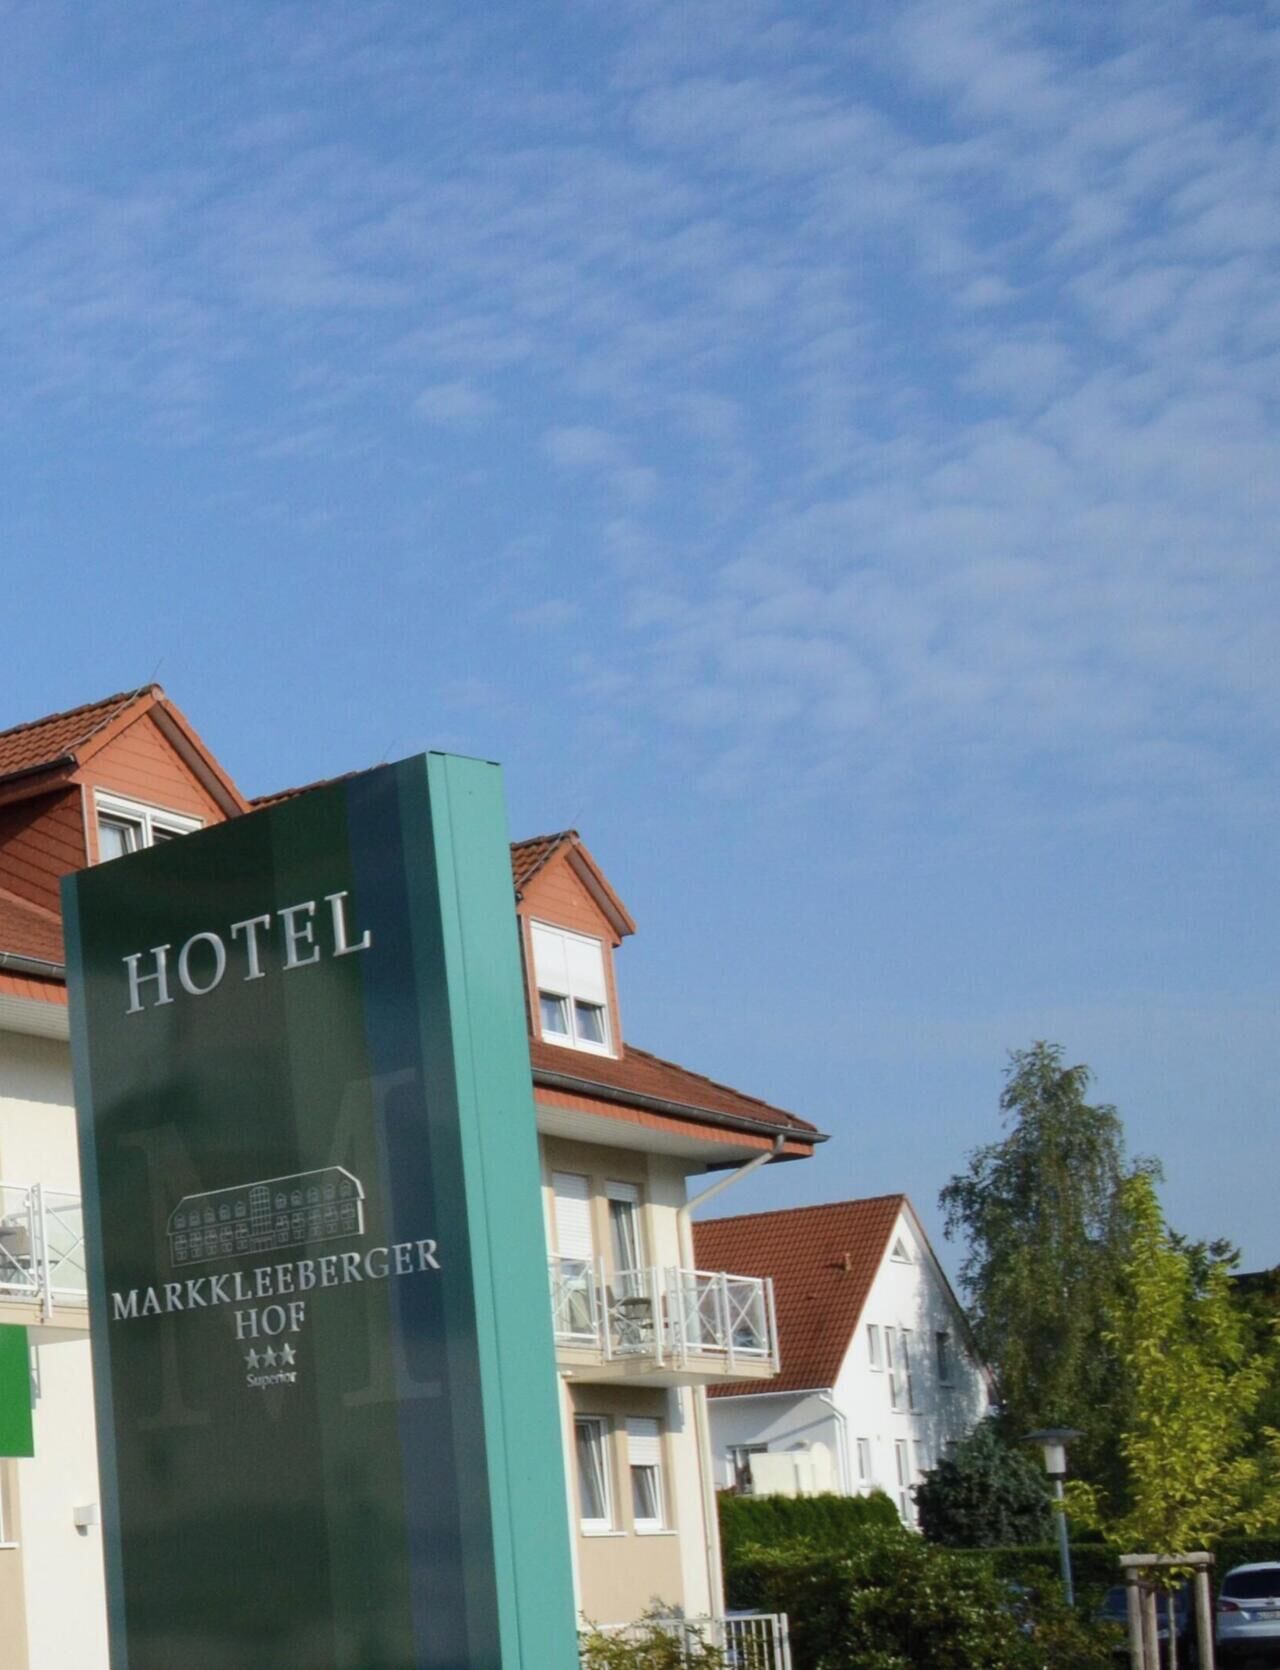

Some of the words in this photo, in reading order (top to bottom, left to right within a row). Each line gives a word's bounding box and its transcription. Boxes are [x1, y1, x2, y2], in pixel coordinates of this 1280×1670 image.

[122, 890, 372, 1015] HOTEL
[111, 1238, 441, 1321] MARKKLEEBERGER
[233, 1301, 306, 1340] HOF
[246, 1370, 297, 1391] Superior
